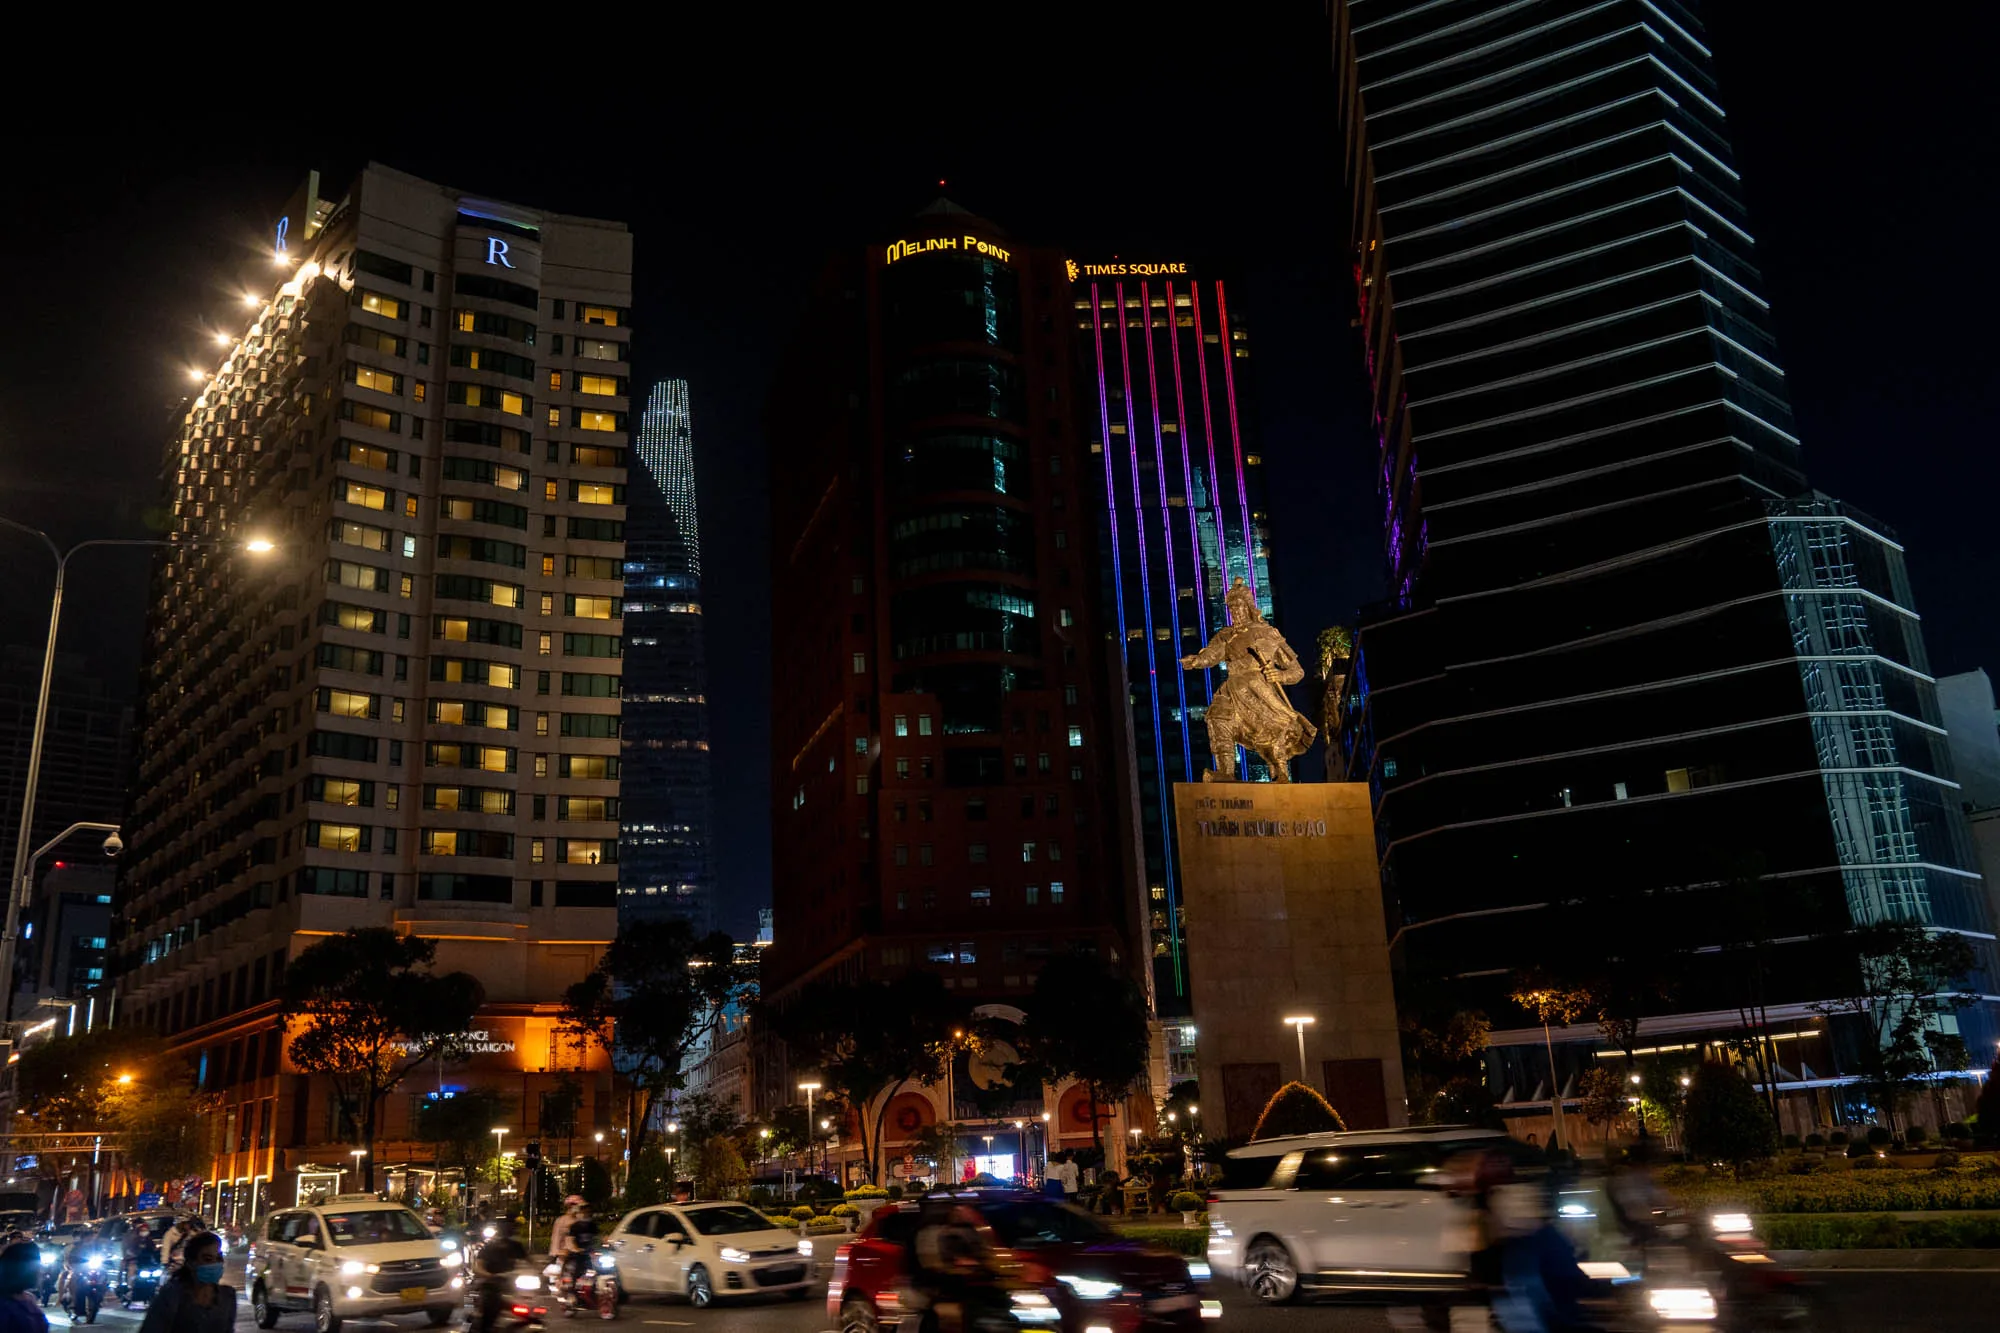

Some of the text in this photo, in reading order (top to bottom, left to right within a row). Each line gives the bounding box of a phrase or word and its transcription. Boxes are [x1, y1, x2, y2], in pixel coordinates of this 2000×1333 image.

[485, 235, 517, 270] R
[886, 235, 1011, 265] MELINH POINT
[1083, 262, 1188, 276] TIMES SQUARE
[476, 1042, 516, 1053] SAIGON
